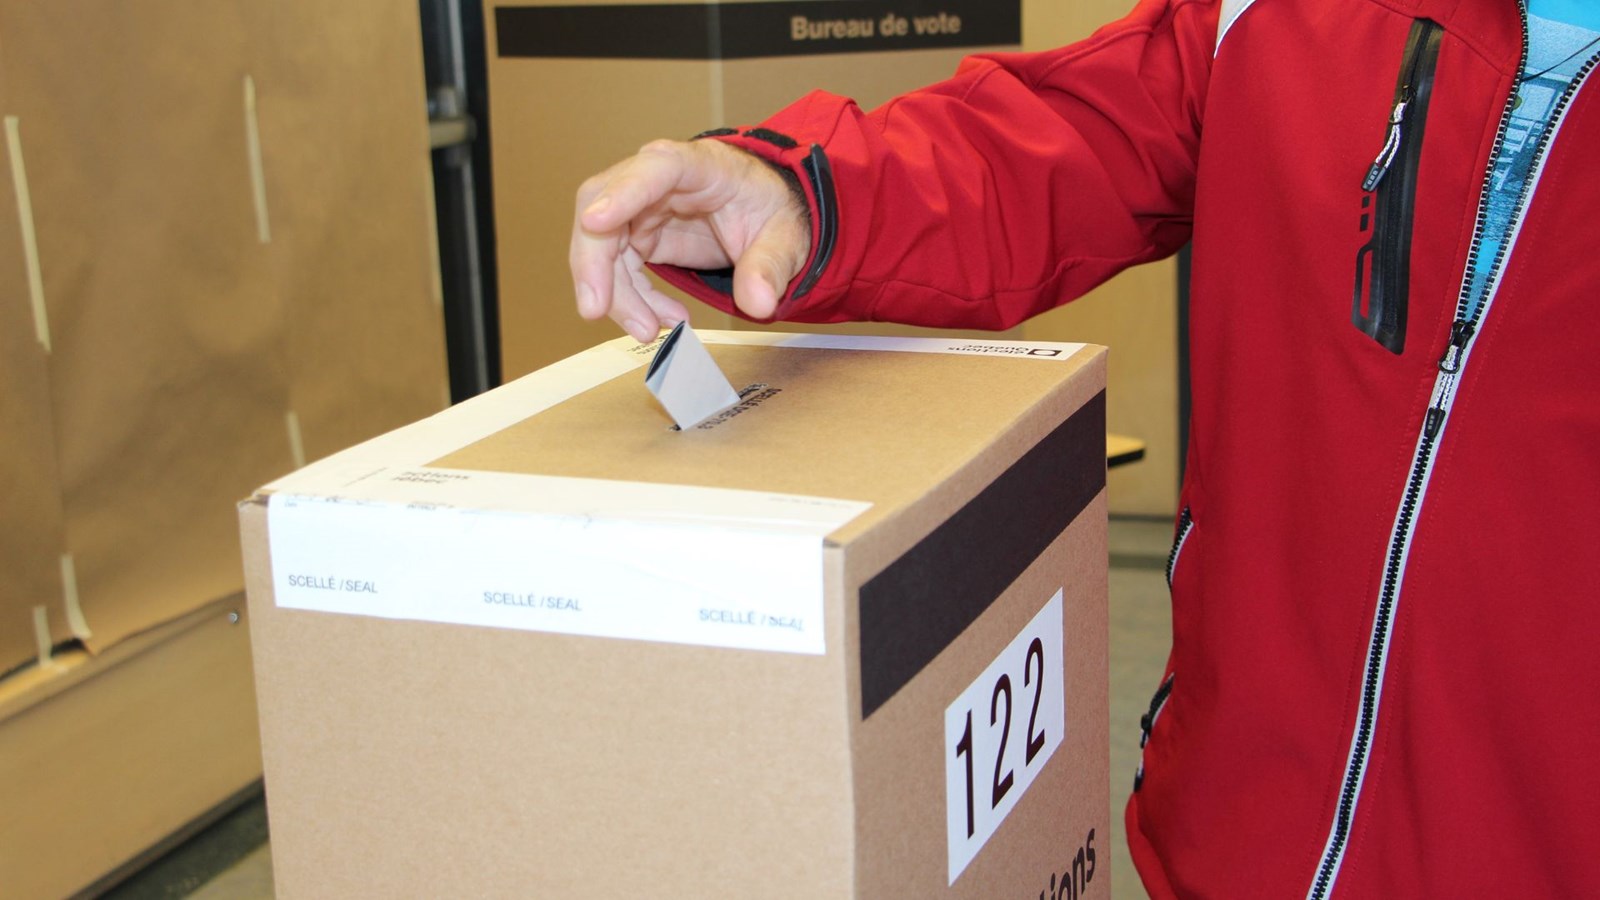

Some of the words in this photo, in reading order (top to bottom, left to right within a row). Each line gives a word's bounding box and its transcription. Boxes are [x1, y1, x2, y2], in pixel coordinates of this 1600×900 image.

[790, 16, 874, 41] Bureau
[879, 13, 908, 37] de
[913, 12, 962, 35] vote
[288, 574, 337, 591] SCELLÉ
[483, 591, 536, 608] SCELLÉ
[955, 637, 1046, 840] 122
